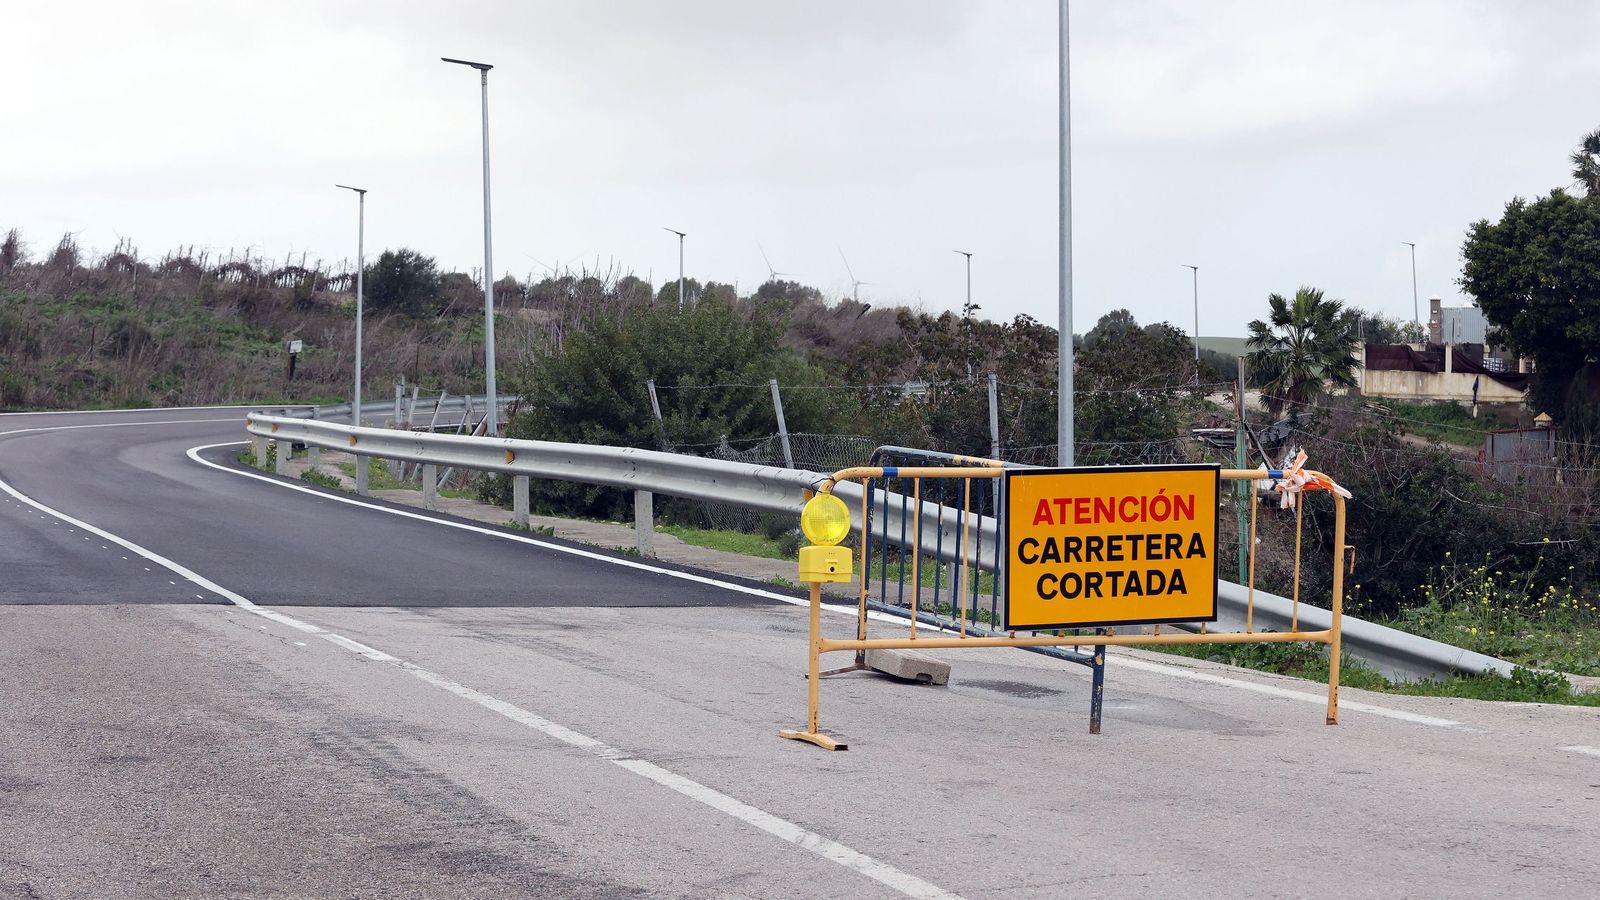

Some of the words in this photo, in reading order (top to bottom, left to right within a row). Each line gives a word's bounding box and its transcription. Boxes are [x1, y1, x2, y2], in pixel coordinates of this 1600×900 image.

[1032, 488, 1195, 526] ATENCIÓN
[1017, 532, 1207, 565] CARRETERA
[1036, 568, 1188, 600] CORTADA
